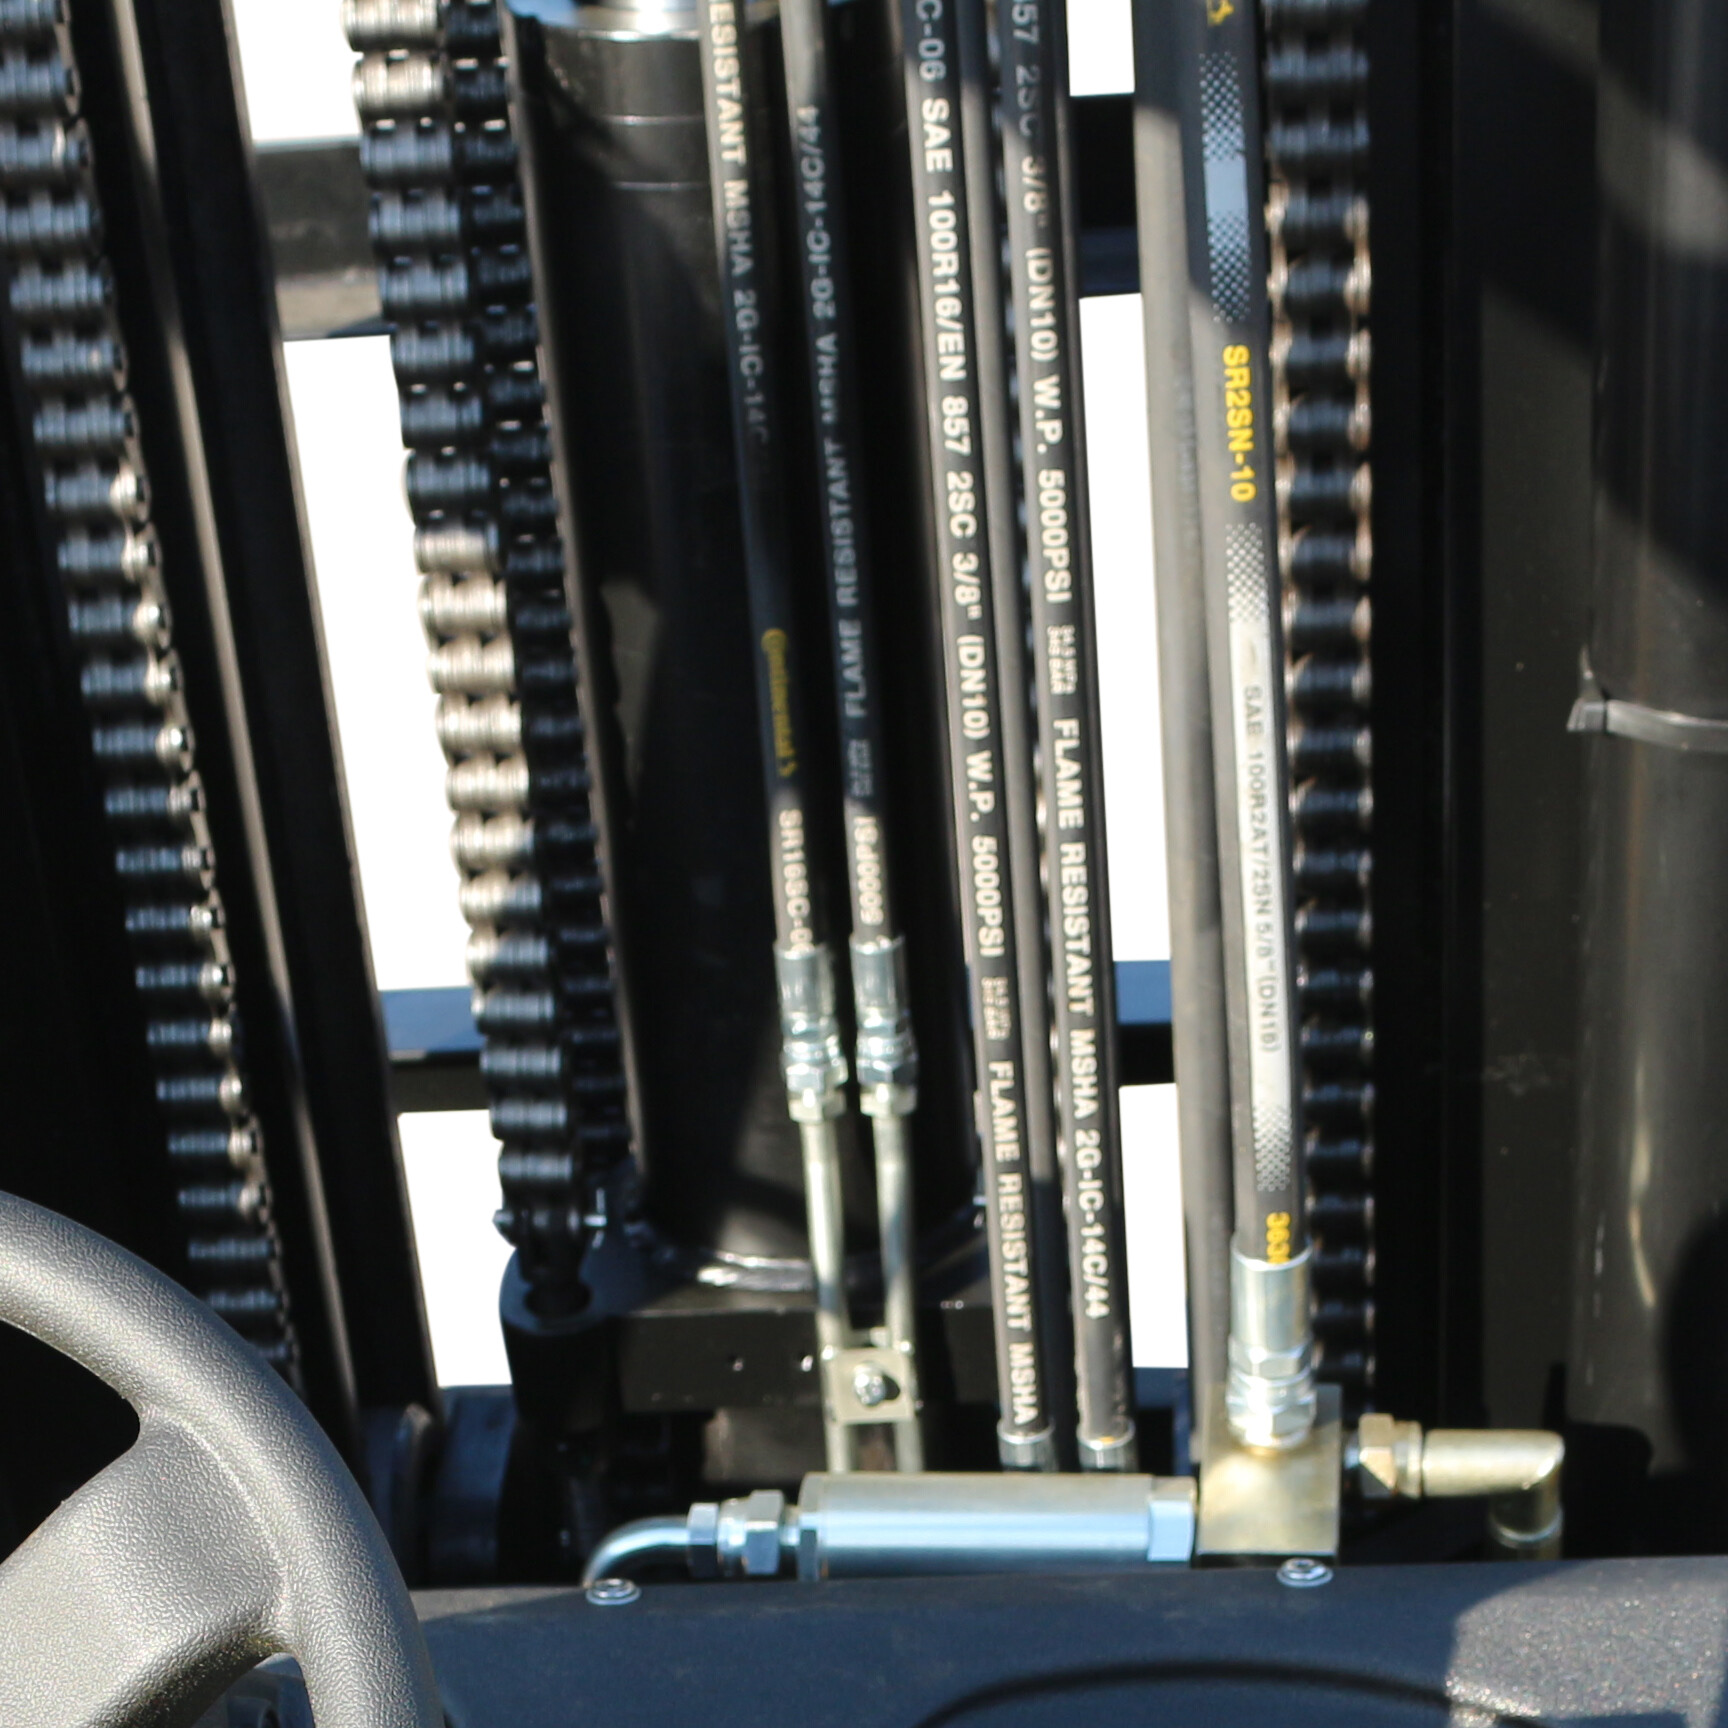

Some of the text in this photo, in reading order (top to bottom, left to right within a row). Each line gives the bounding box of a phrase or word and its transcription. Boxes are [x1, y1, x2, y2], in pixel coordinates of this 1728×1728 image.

[709, 0, 747, 165] ESISTANT
[921, 97, 953, 173] SAE
[723, 180, 755, 276] MSHA
[796, 106, 836, 320] 2G-IC-14C/44
[928, 190, 967, 381] 100R16/EN
[1011, 0, 1073, 603] 57 2SC 3/8" (DN10) W.P. 5000PSI
[941, 396, 971, 456] 857
[1222, 344, 1257, 503] SR2SN-10
[824, 438, 859, 606] RESISTANT
[946, 471, 977, 538] 2SC
[951, 552, 981, 619] 3/8"
[839, 619, 868, 718] FLAME
[956, 635, 990, 738] (DN10)
[1244, 685, 1265, 735] SAE
[966, 752, 994, 821] W.P.
[1248, 752, 1274, 915] 100R2AT/2SN
[854, 816, 884, 926] 5000PSI
[972, 836, 1005, 957] 5000PSI
[1052, 719, 1111, 1319] FLAME RESISTANT MSHA 2G-IC-14C/44
[988, 1061, 1038, 1425] FLAME RESISTANT MSHA
